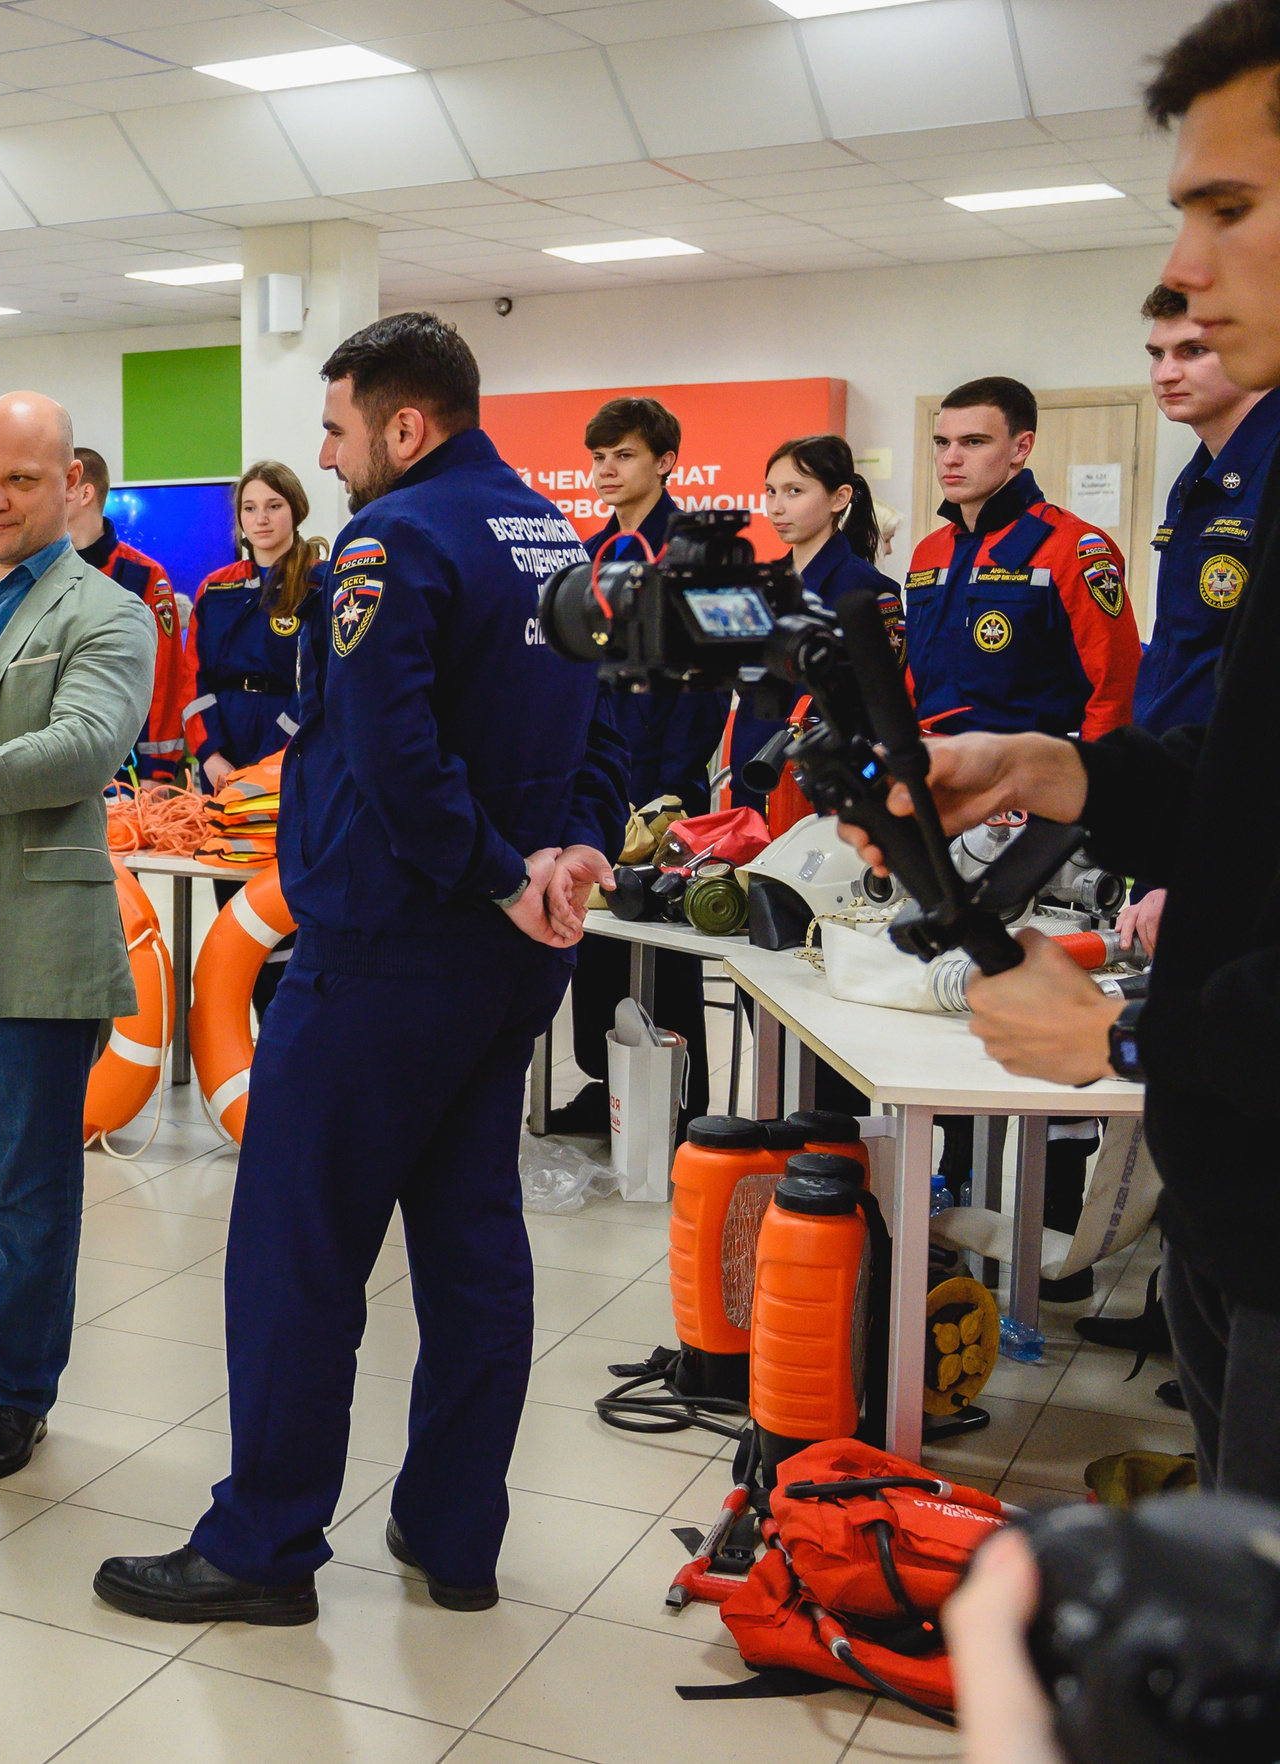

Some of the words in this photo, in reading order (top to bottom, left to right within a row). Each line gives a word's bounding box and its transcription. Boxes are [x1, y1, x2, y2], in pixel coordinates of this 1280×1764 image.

[538, 465, 721, 490] ЧЕМНАТ
[341, 556, 377, 570] РОССИЯ
[343, 577, 364, 589] ВСКС
